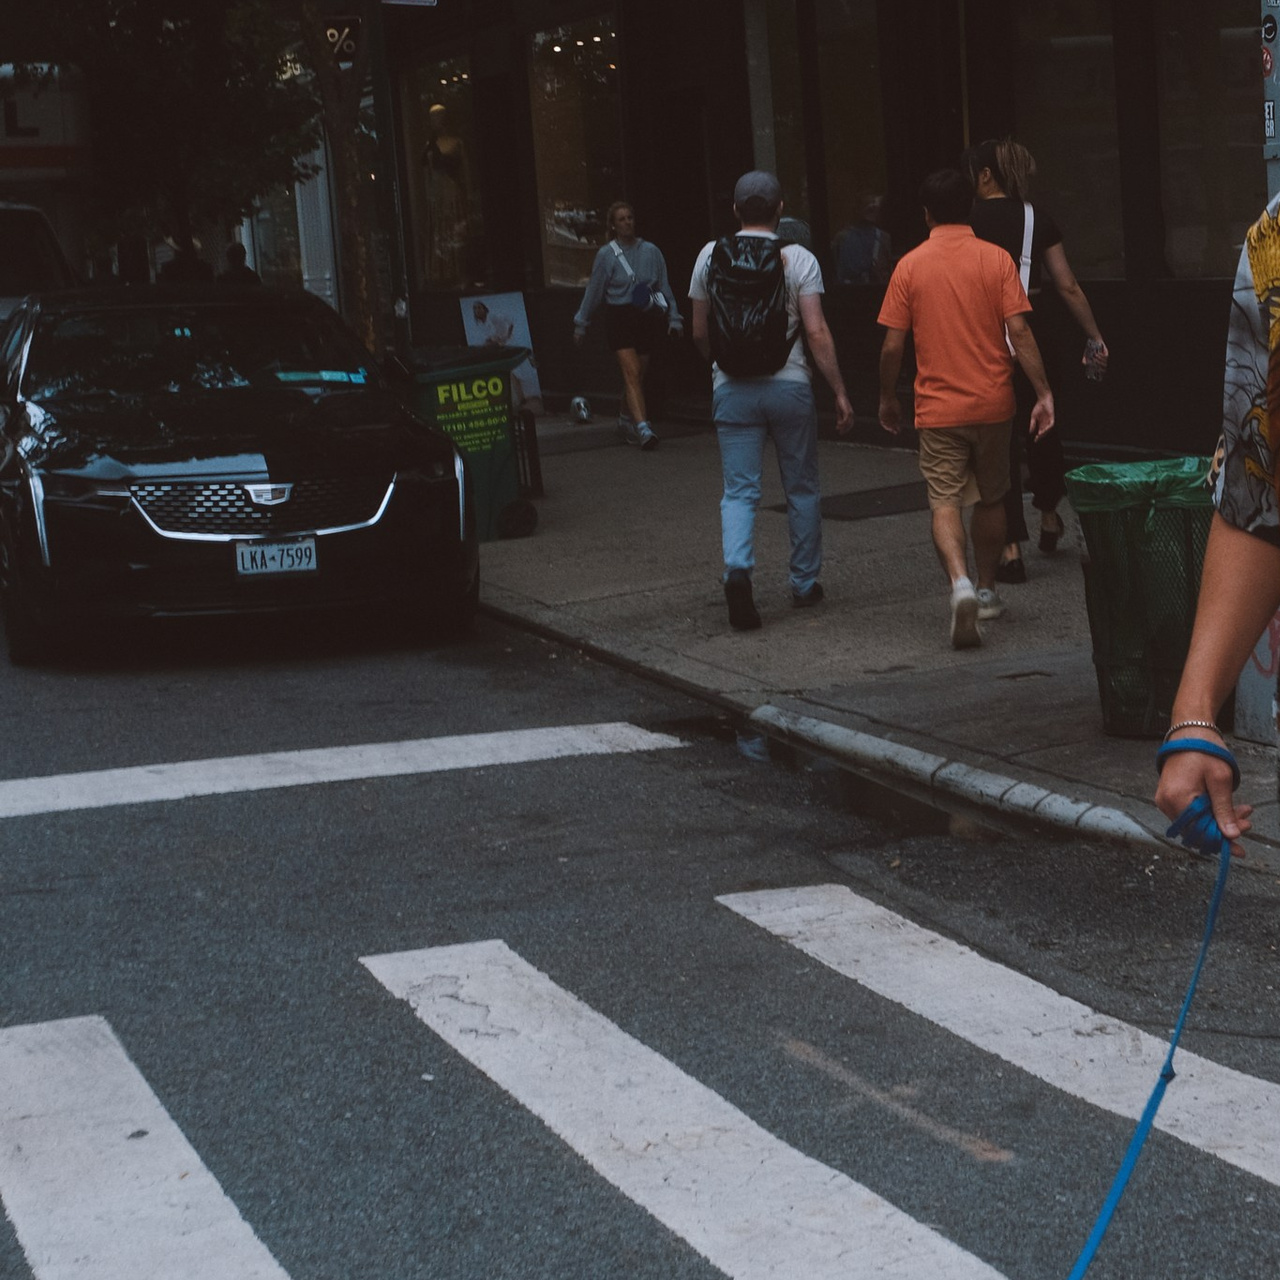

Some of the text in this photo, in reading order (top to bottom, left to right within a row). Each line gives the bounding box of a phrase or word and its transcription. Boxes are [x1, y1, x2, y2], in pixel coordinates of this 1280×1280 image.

[437, 376, 503, 404] FILCO
[241, 546, 312, 571] LKA 7599
